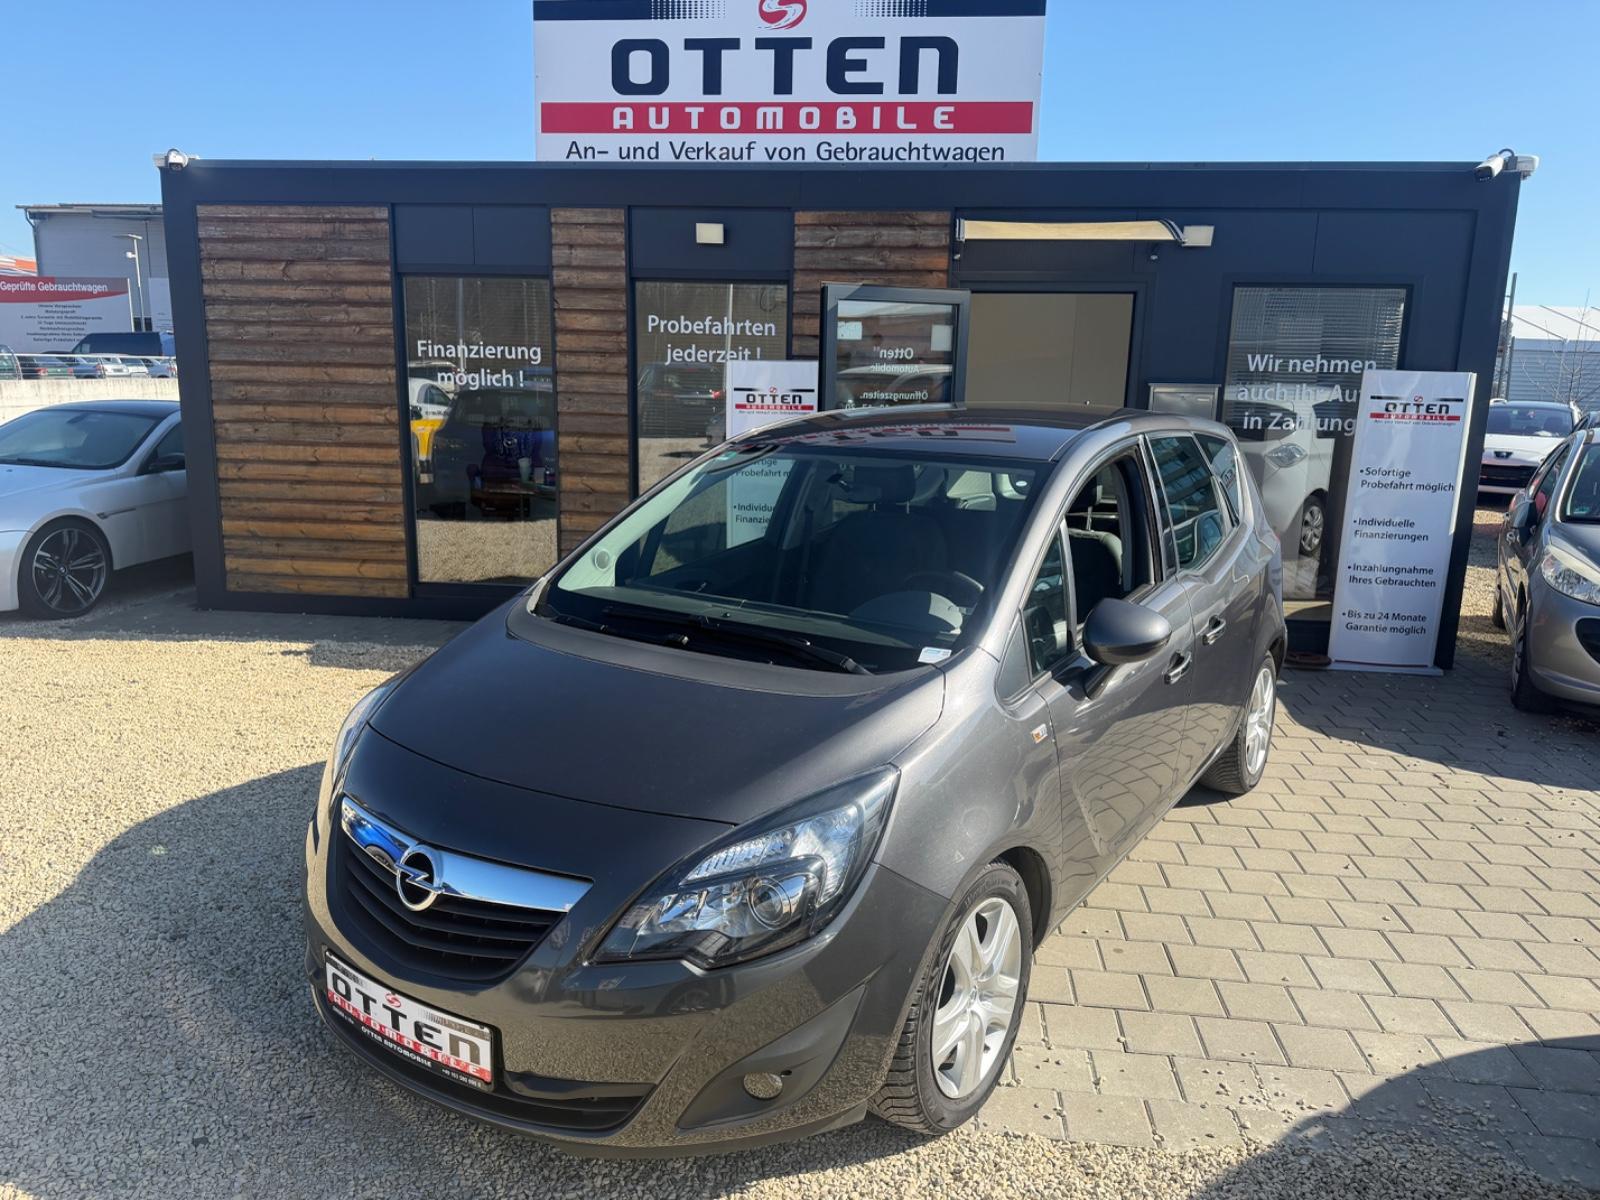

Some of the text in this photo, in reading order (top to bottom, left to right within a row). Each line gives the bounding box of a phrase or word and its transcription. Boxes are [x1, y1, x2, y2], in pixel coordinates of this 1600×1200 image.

[611, 36, 959, 95] OTTEN
[612, 106, 956, 130] AUTOMOBILE
[566, 141, 1005, 162] An- und Verkauf von Gebrauchtwagen
[0, 281, 108, 294] Geprüfte Gebrauchtwagen
[647, 314, 776, 336] Probefahrten
[417, 340, 542, 364] Finanzierung
[664, 344, 751, 365] jederzeit
[1247, 354, 1377, 374] Wir nehmen
[437, 368, 525, 391] möglich !
[746, 393, 802, 404] OTTEN
[1237, 382, 1287, 401] auch
[1328, 384, 1362, 402] Au
[1384, 402, 1450, 414] OTTEN
[1243, 412, 1263, 430] in
[1364, 467, 1411, 479] Sofortige
[1360, 480, 1455, 493] Probefahrt möglich
[1358, 518, 1415, 528] Individuelle
[1354, 530, 1429, 542] Finanzierungen
[1353, 563, 1434, 575] Inzahlungnahme
[1349, 575, 1436, 587] Ihres Gebrauchten
[1347, 610, 1361, 619] Bis
[1377, 611, 1389, 620] 24
[1392, 612, 1427, 622] Monate
[1345, 623, 1427, 636] Garantie möglich
[332, 971, 481, 1066] OTTEN
[333, 993, 480, 1077] AUTOMOBILE
[383, 1039, 432, 1068] AUTOMOBILE
